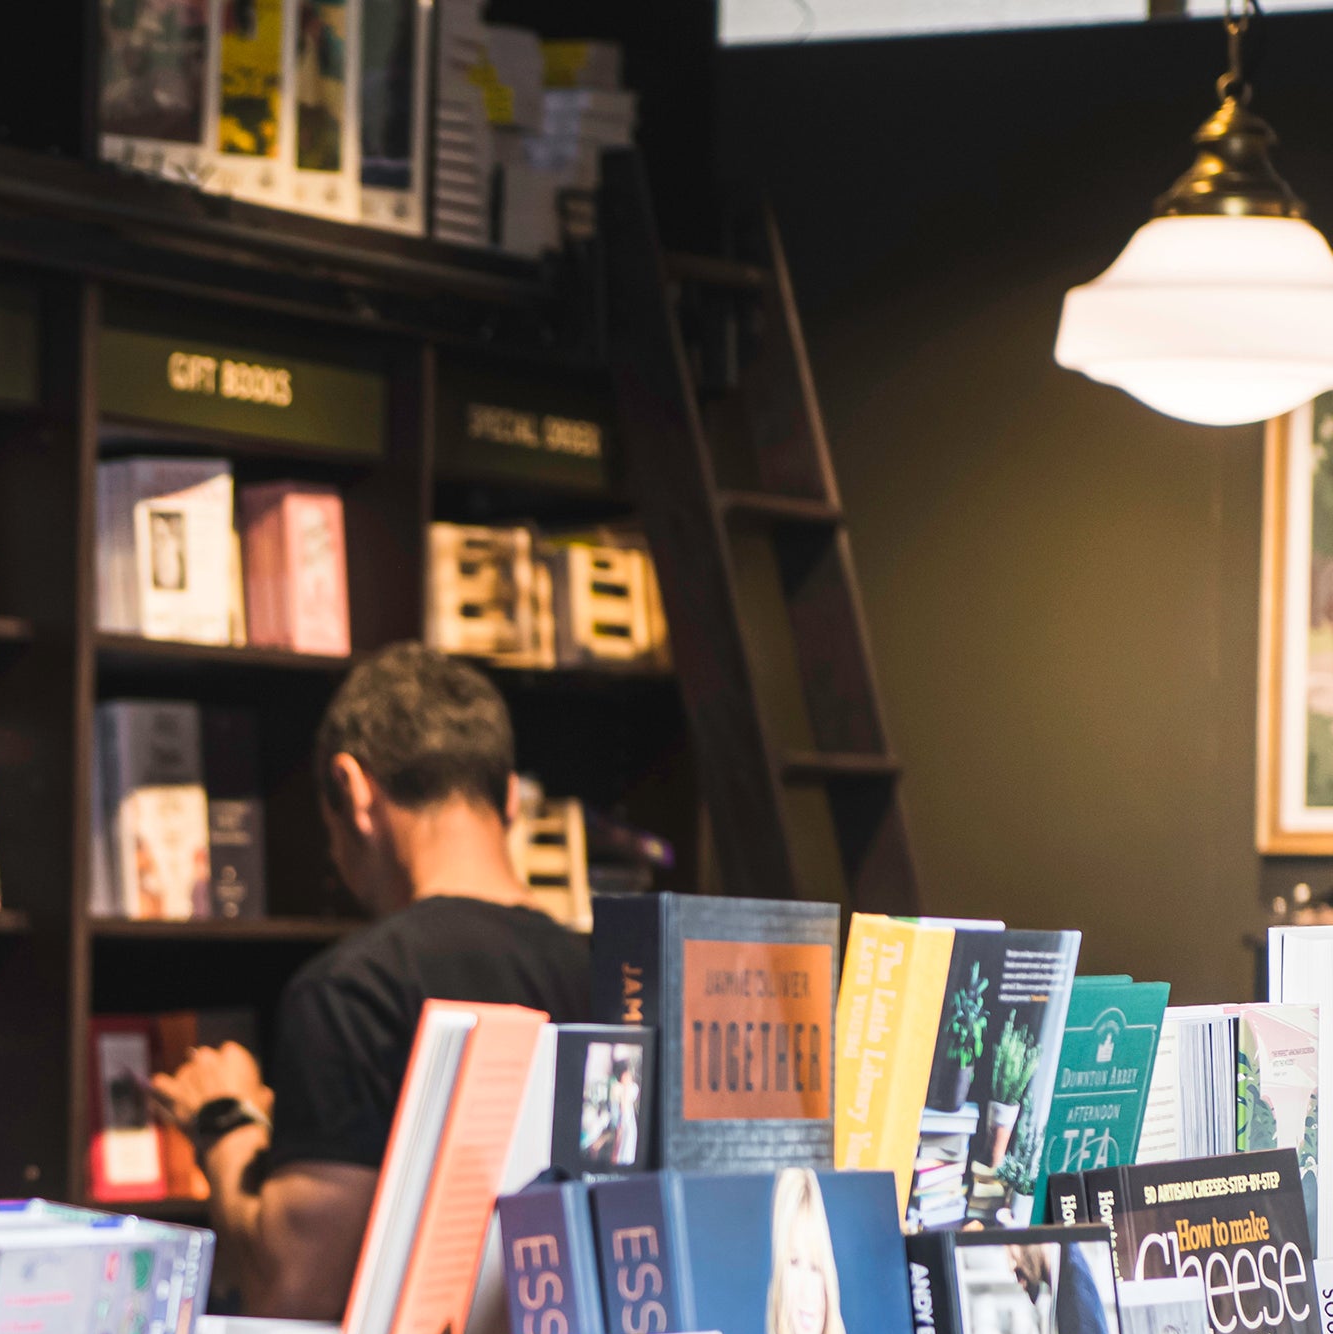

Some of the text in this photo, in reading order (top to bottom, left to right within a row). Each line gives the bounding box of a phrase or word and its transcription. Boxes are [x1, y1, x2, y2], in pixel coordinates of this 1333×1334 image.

[166, 350, 293, 408] GIFT BOOKS
[621, 961, 644, 1023] JAM
[692, 1019, 823, 1093] TOGETHER
[847, 941, 905, 1124] The Little Library
[1066, 1103, 1121, 1123] AFTERNOON
[1059, 1127, 1111, 1174] TEA
[1143, 1185, 1157, 1205] 50
[1158, 1181, 1192, 1204] ARTISAN
[1175, 1209, 1271, 1252] How to make
[909, 1261, 936, 1329] ANDY
